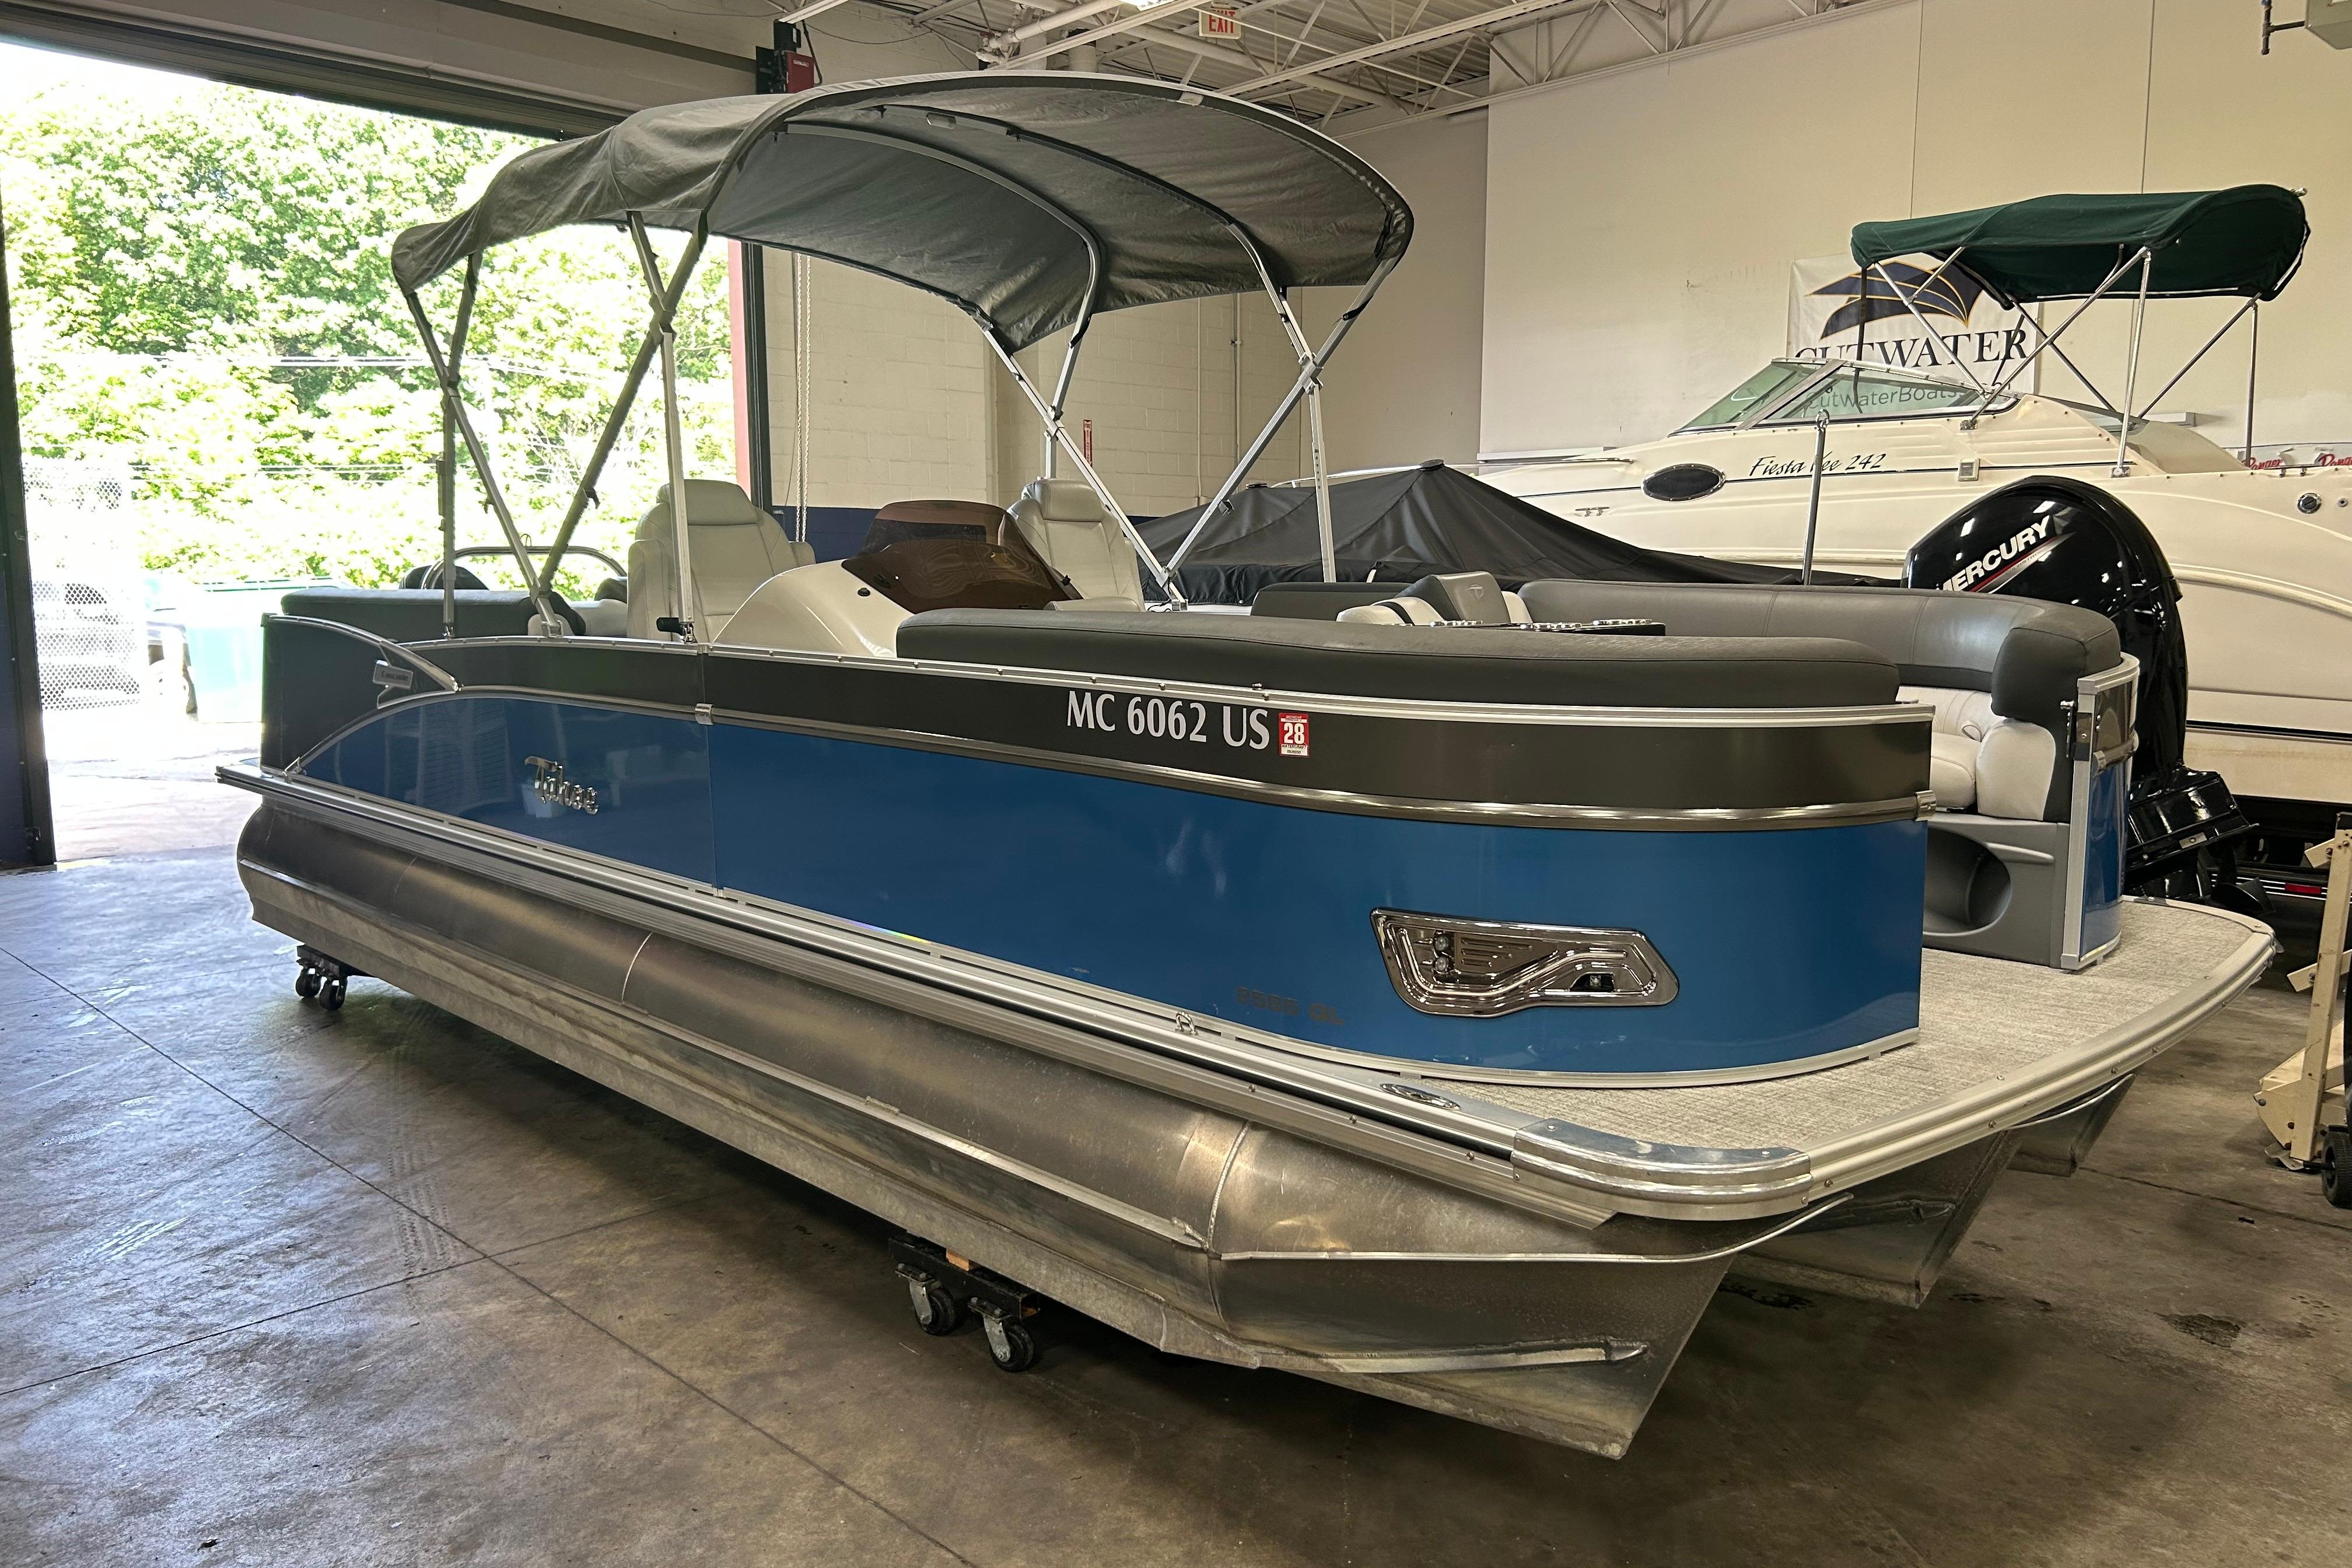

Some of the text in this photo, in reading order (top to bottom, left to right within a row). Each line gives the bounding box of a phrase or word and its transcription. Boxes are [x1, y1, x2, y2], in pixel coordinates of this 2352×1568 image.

[1209, 9, 1235, 33] EXIT
[1749, 456, 1807, 476] Fiesta
[1845, 453, 1886, 470] 242
[1067, 691, 1270, 750] MC 6062 US
[1284, 722, 1305, 744] 28
